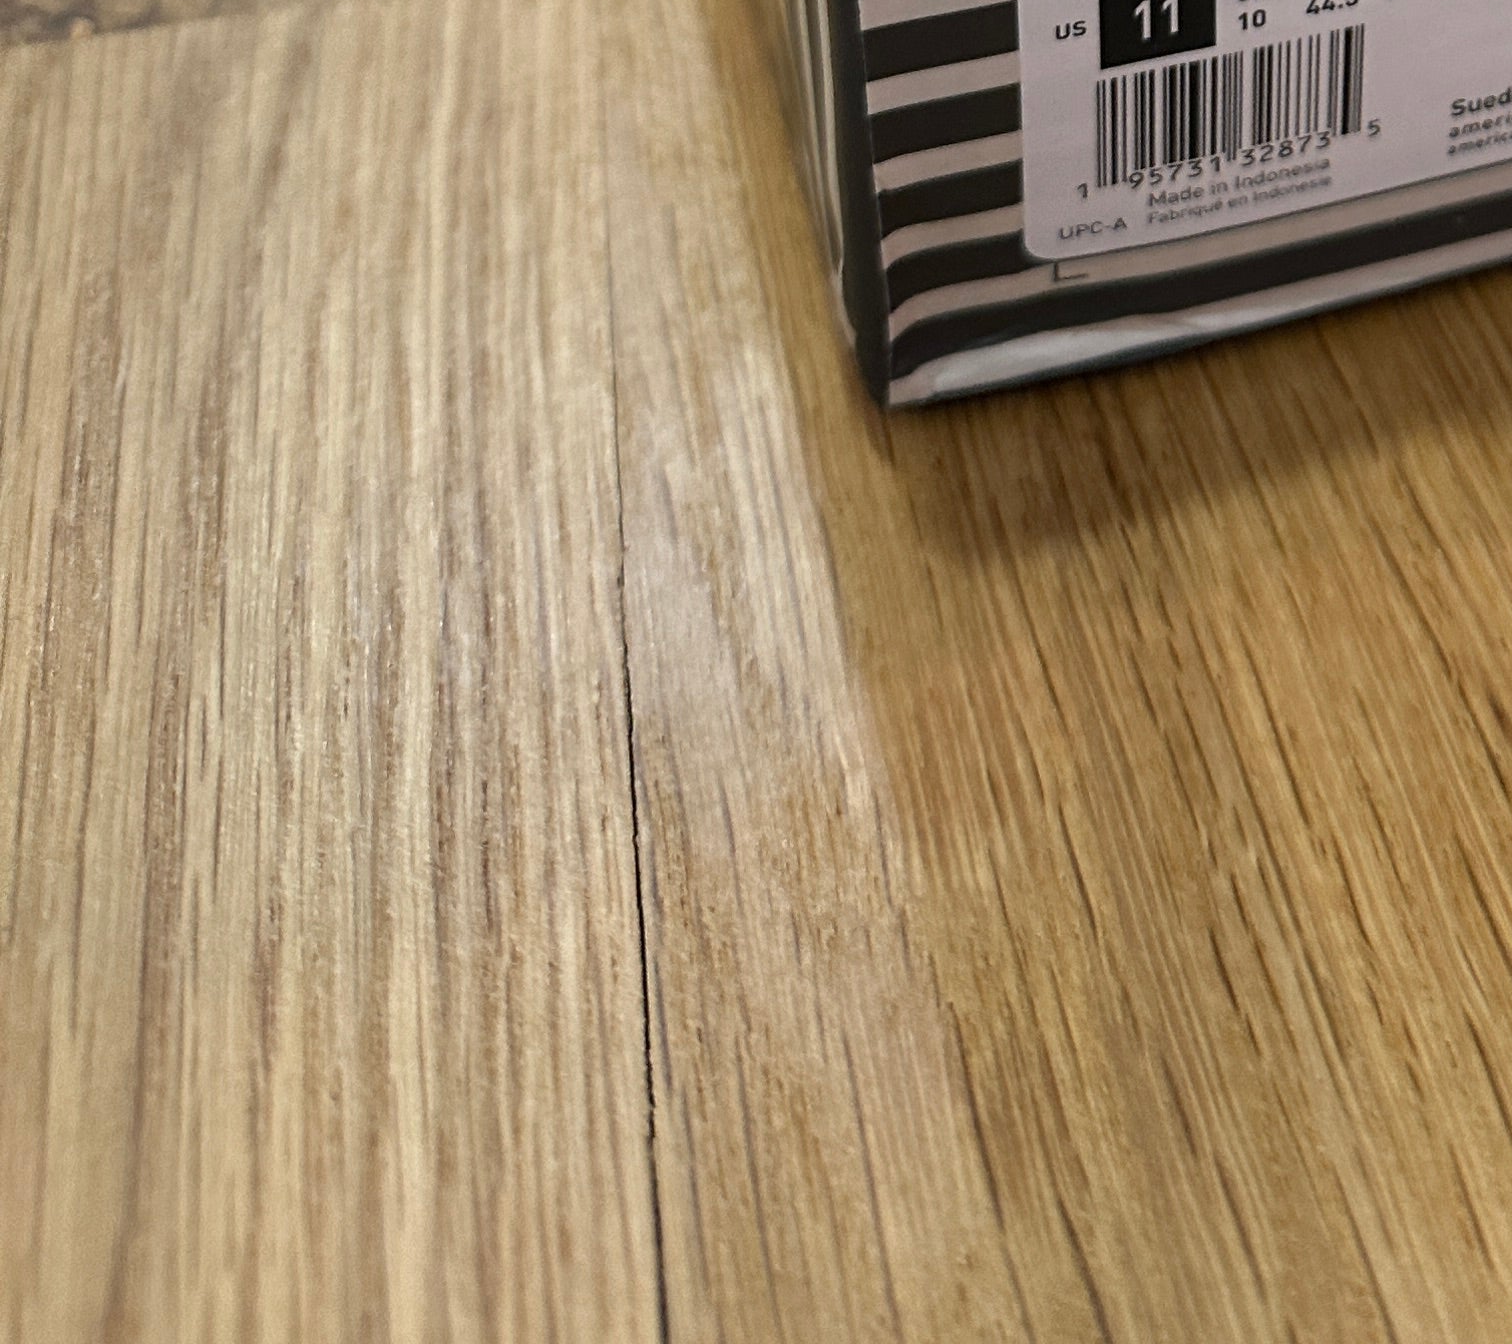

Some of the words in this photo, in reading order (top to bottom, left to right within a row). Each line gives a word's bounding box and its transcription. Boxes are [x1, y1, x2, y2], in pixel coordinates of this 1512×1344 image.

[1055, 20, 1087, 40] US
[1238, 9, 1267, 31] 10
[1147, 186, 1204, 207] Made
[1234, 158, 1331, 190] Indonesia
[1057, 217, 1128, 240] UPC-A
